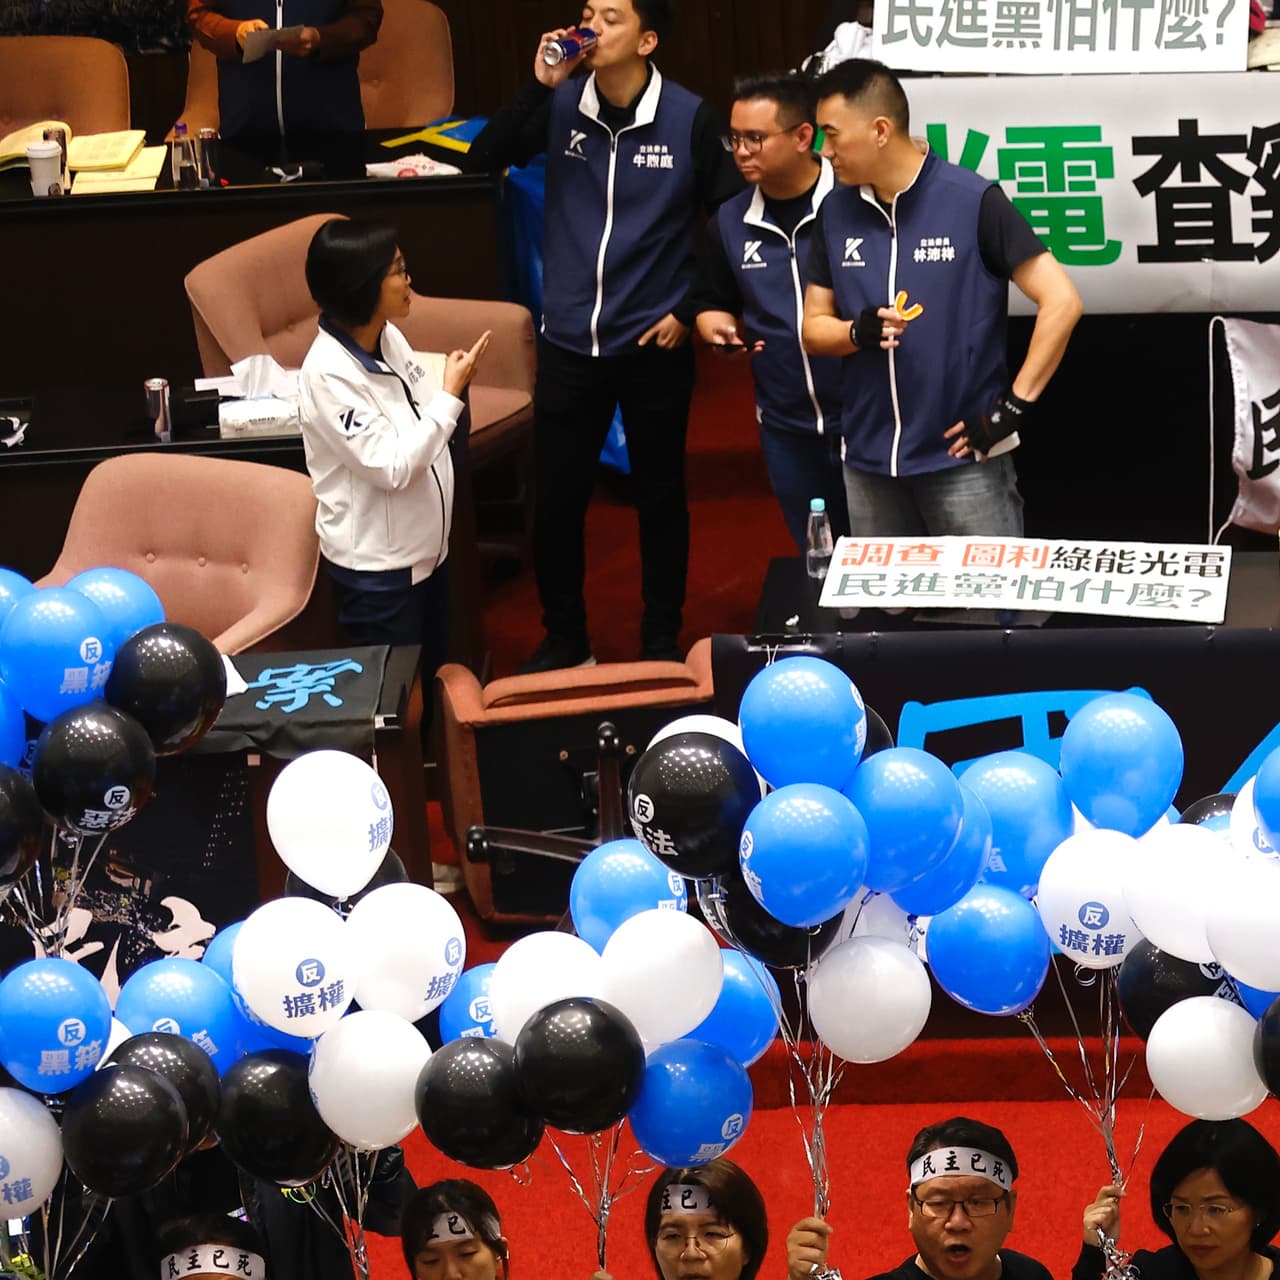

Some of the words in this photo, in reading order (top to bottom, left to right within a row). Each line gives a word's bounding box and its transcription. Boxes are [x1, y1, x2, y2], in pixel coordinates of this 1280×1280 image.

[881, 0, 1231, 51] 民進黨怕什麼?
[913, 246, 955, 263] 林沛祥
[841, 541, 943, 569] 調查
[963, 543, 1226, 579] 圖利綠能光電
[832, 572, 1211, 608] 民進黨怕什麼?
[1059, 924, 1126, 957] 擴權
[282, 979, 346, 1020] 擴權
[37, 1039, 103, 1076] 黑箱
[922, 1150, 1004, 1183] 民主已死
[168, 1248, 252, 1276] 民主已死
